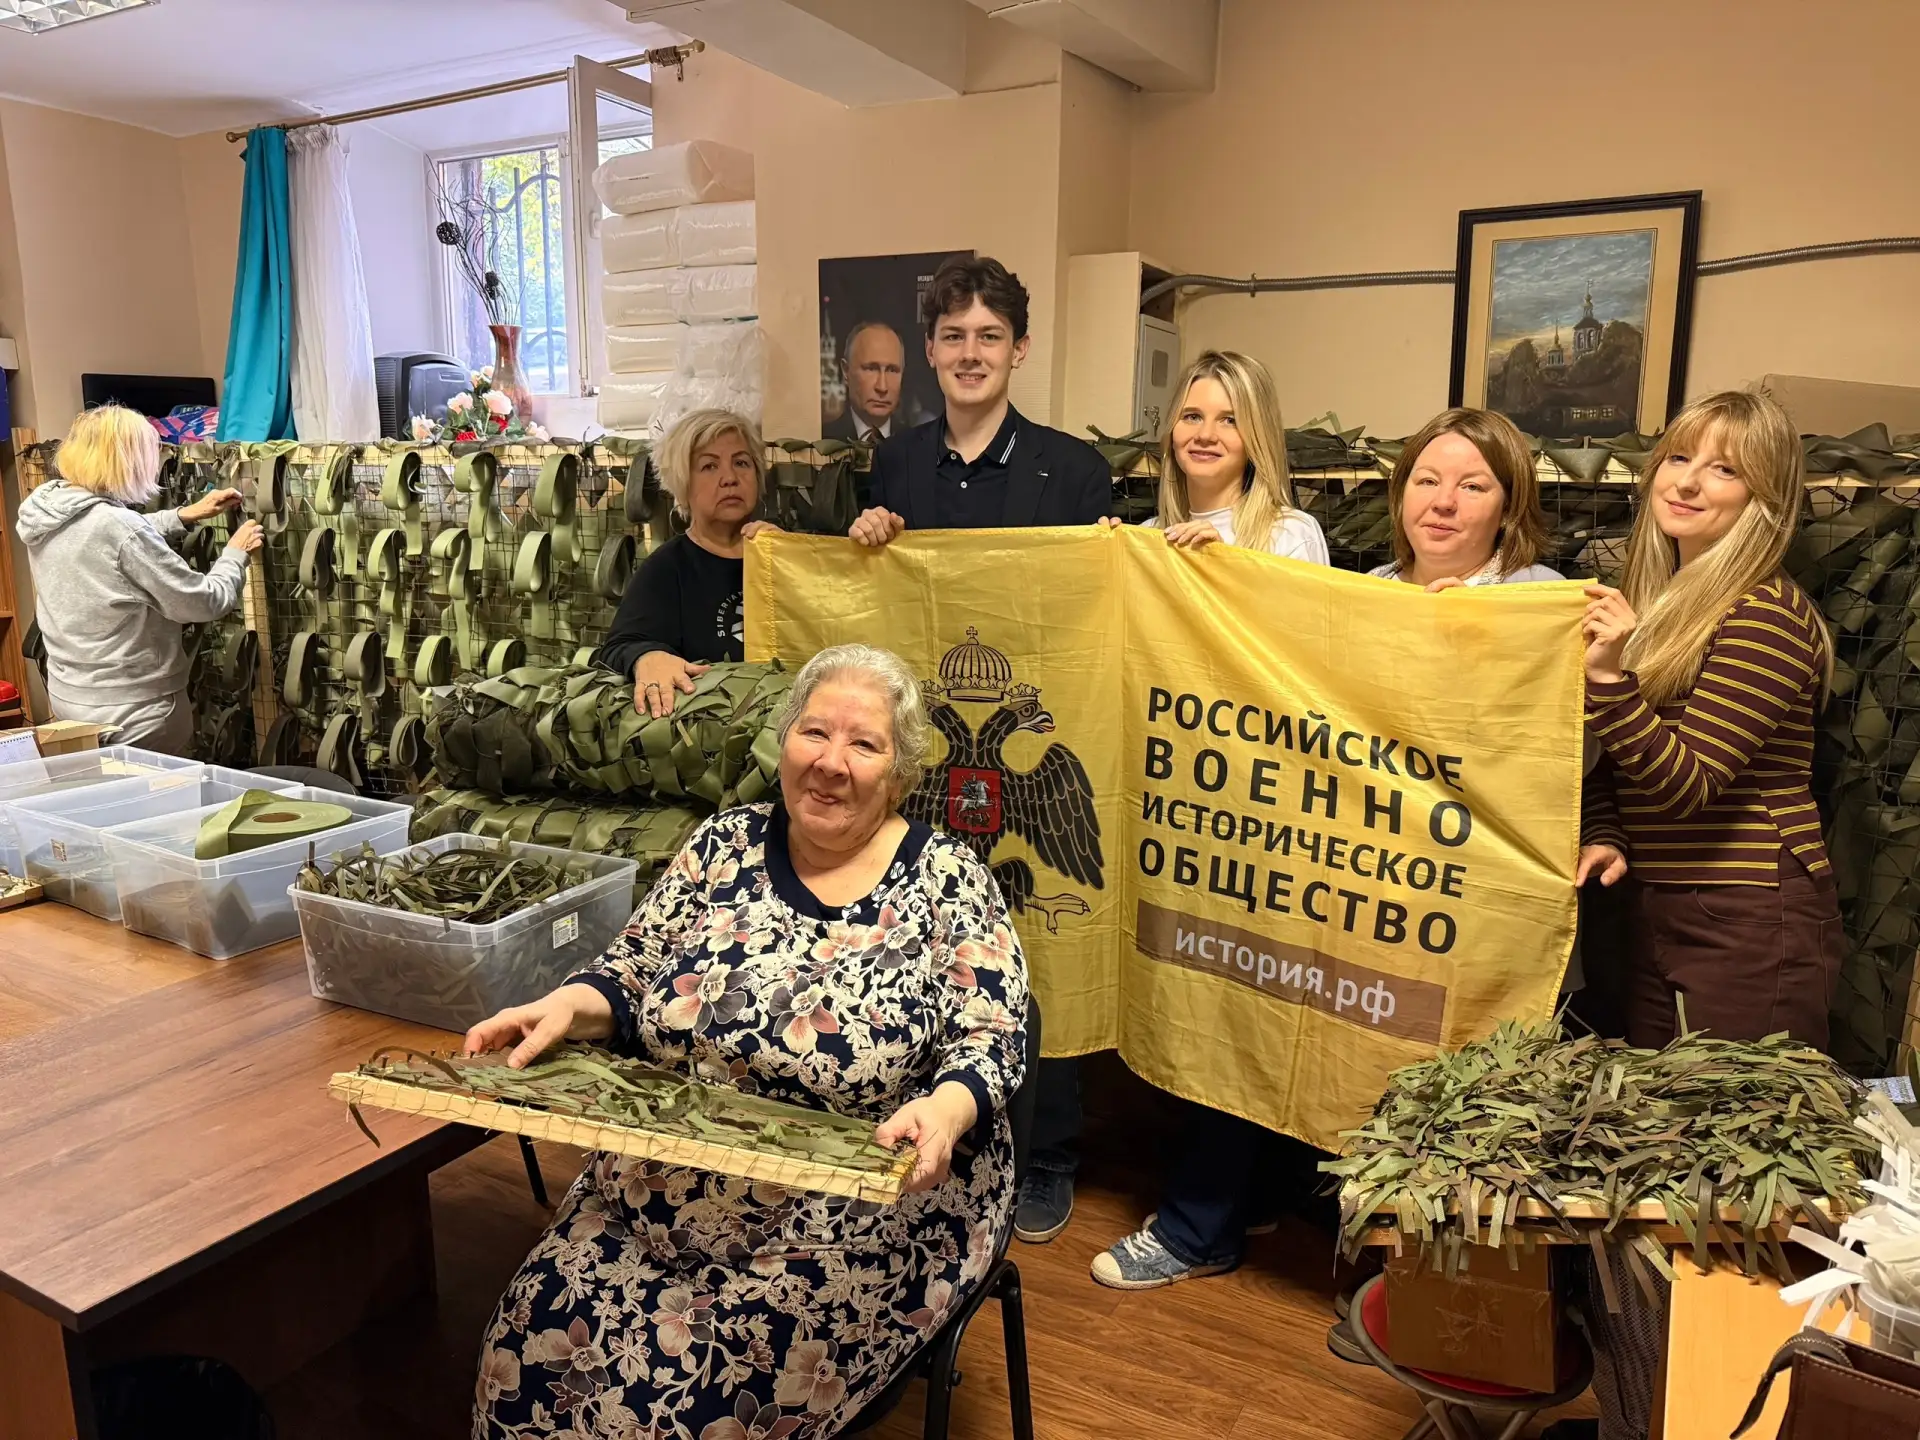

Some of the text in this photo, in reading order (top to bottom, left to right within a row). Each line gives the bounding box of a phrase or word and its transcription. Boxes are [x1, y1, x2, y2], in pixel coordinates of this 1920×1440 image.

[1145, 736, 1472, 848] ВОЕННО
[1148, 687, 1463, 792] РОССИЙСКОЕ
[1139, 838, 1457, 955] ОБЩЕСТВО
[1142, 792, 1467, 898] ИСТОРИЧЕСКОЕ
[1175, 928, 1396, 1024] история.рф
